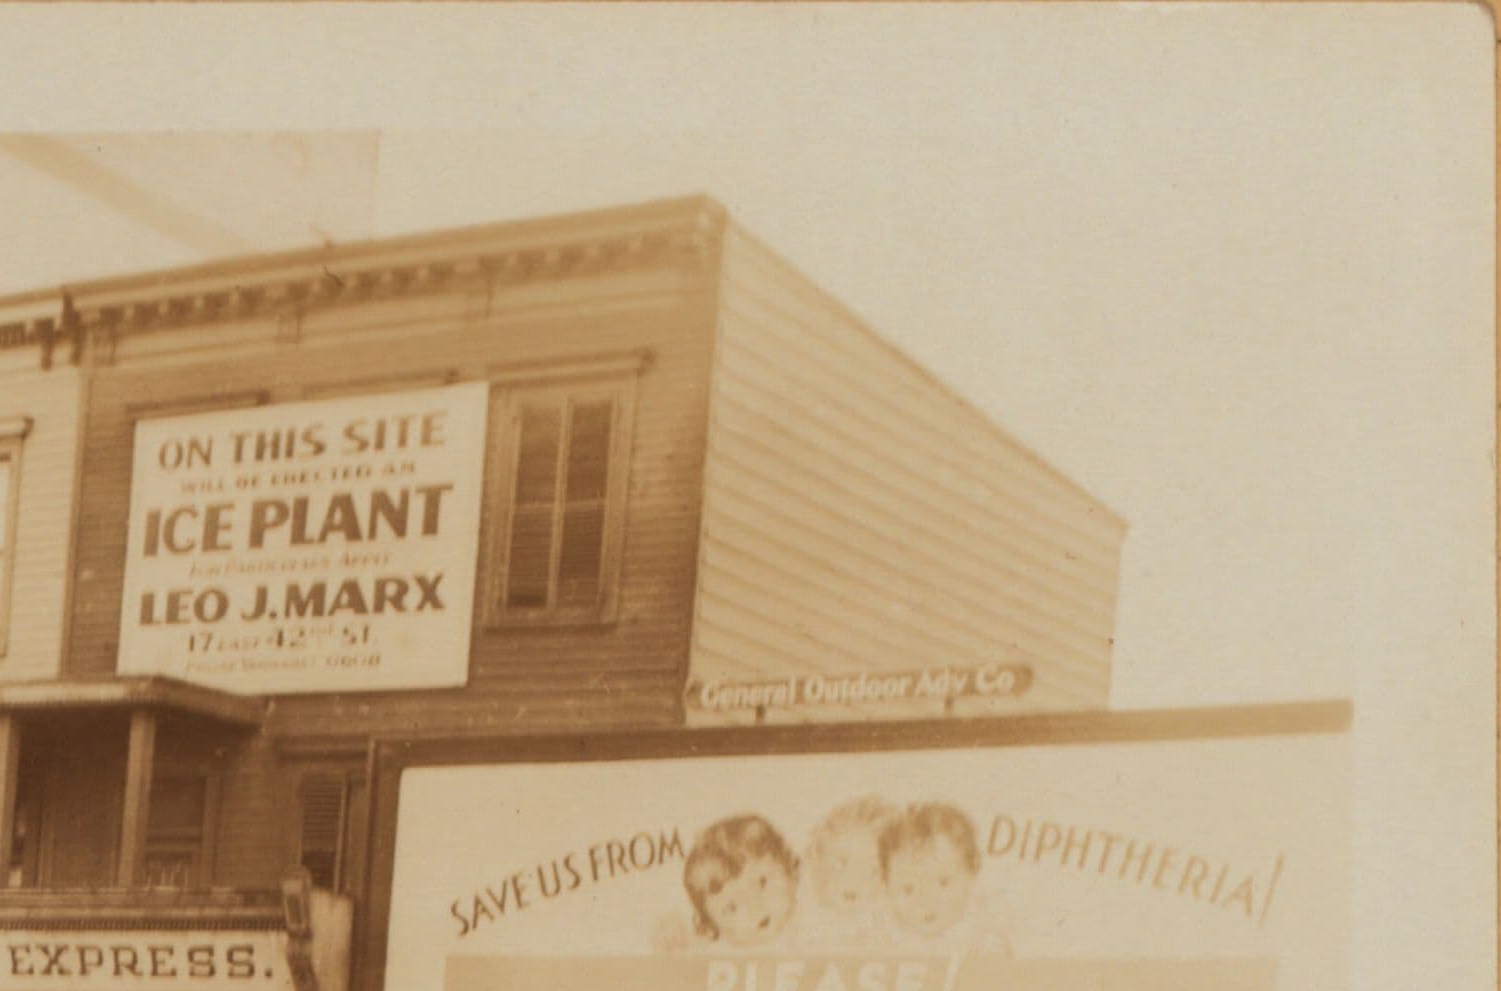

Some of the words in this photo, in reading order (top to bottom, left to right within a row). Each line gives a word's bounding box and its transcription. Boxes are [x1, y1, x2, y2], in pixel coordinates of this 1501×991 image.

[158, 434, 213, 471] ON
[229, 423, 326, 464] THIS
[342, 409, 449, 454] SITE
[270, 463, 373, 488] ERECTED
[382, 460, 417, 476] AN
[143, 503, 235, 557] ICE
[249, 483, 454, 549] PLANT
[139, 588, 229, 627] LEO
[188, 632, 213, 652] 17
[700, 675, 796, 710] General
[804, 670, 913, 706] Outdoor
[450, 870, 530, 937] SAVE
[537, 855, 582, 899] US
[587, 826, 684, 882] FROM
[9, 943, 275, 980] EXPRESS.
